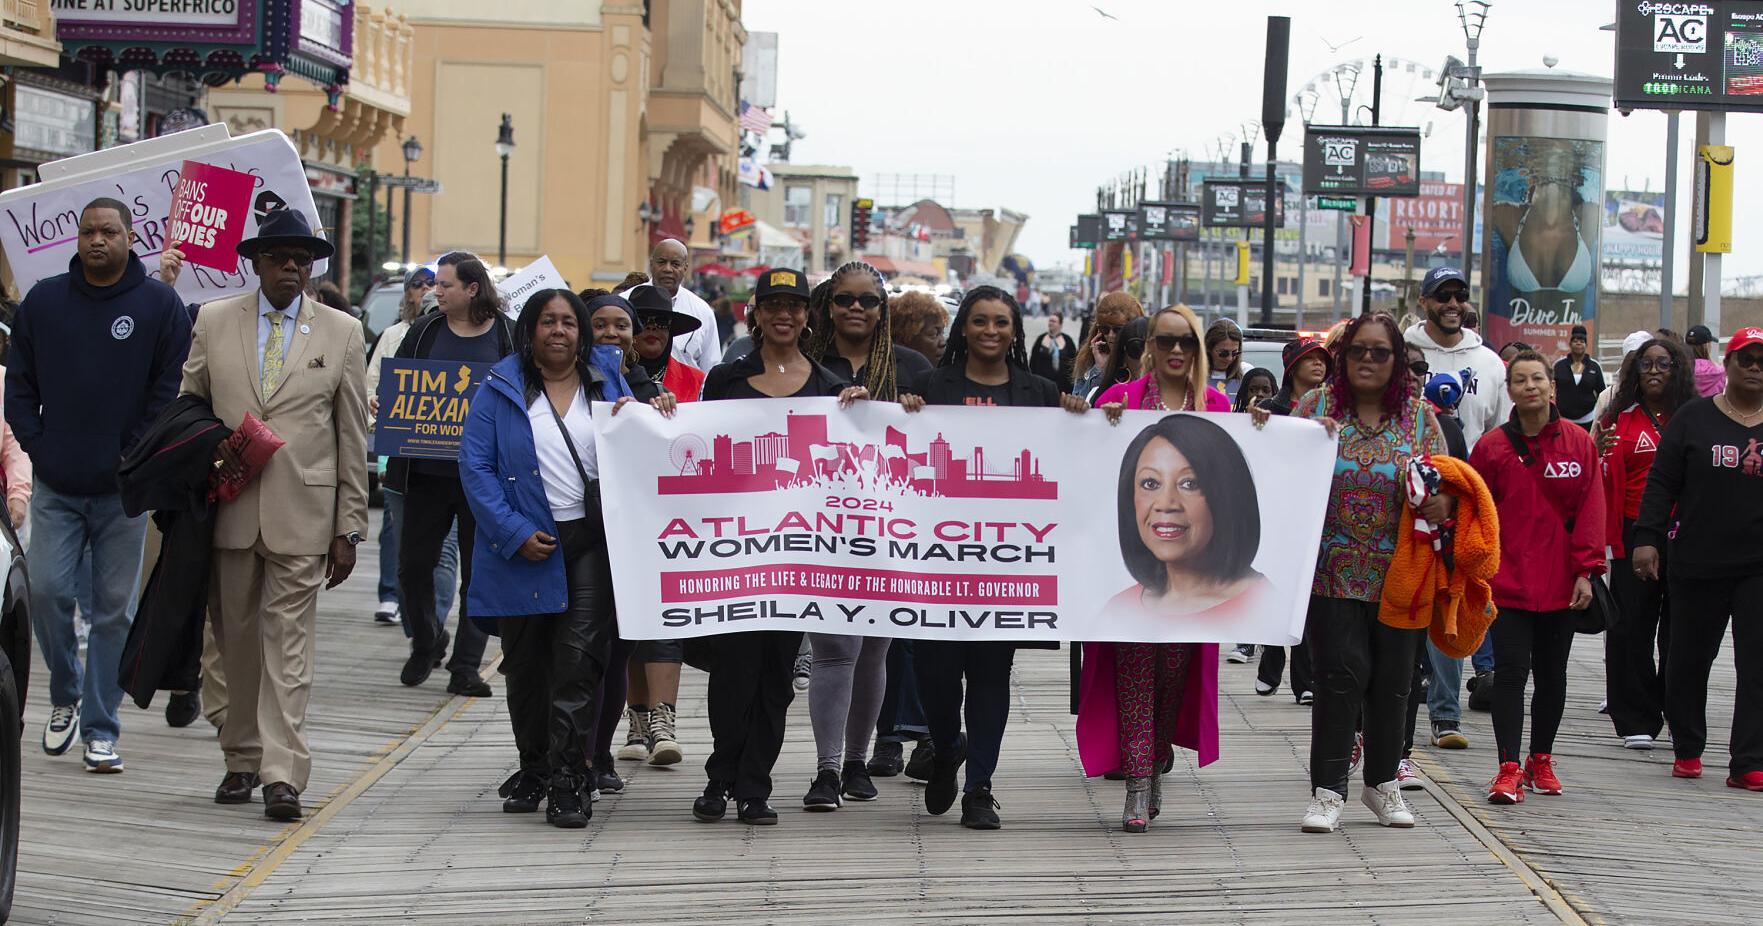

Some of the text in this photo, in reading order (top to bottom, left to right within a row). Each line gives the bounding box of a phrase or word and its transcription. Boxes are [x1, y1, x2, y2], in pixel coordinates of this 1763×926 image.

[93, 0, 115, 11] AT
[123, 0, 236, 14] SUPERFRICO
[1656, 18, 1704, 43] AC
[1328, 146, 1353, 160] AC
[179, 179, 208, 202] BANS
[190, 203, 228, 230] OUR
[1396, 199, 1463, 219] RESORT
[1509, 298, 1558, 327] Dive
[1523, 328, 1557, 337] SUMMER
[394, 369, 447, 394] TIM
[415, 423, 438, 435] FOR
[1712, 445, 1739, 468] 19
[1543, 461, 1581, 478] ΔΣΘ
[825, 496, 894, 513] 2024
[658, 511, 1058, 543] ATLANTIC CITY
[658, 533, 1055, 563] WOMEN'S MARCH
[679, 571, 1040, 598] HONORING THE LIFE & LEGACY OF THE HONORABLE LT. GOVERNOR
[661, 600, 1058, 629] SHEILA Y. OLIVER
